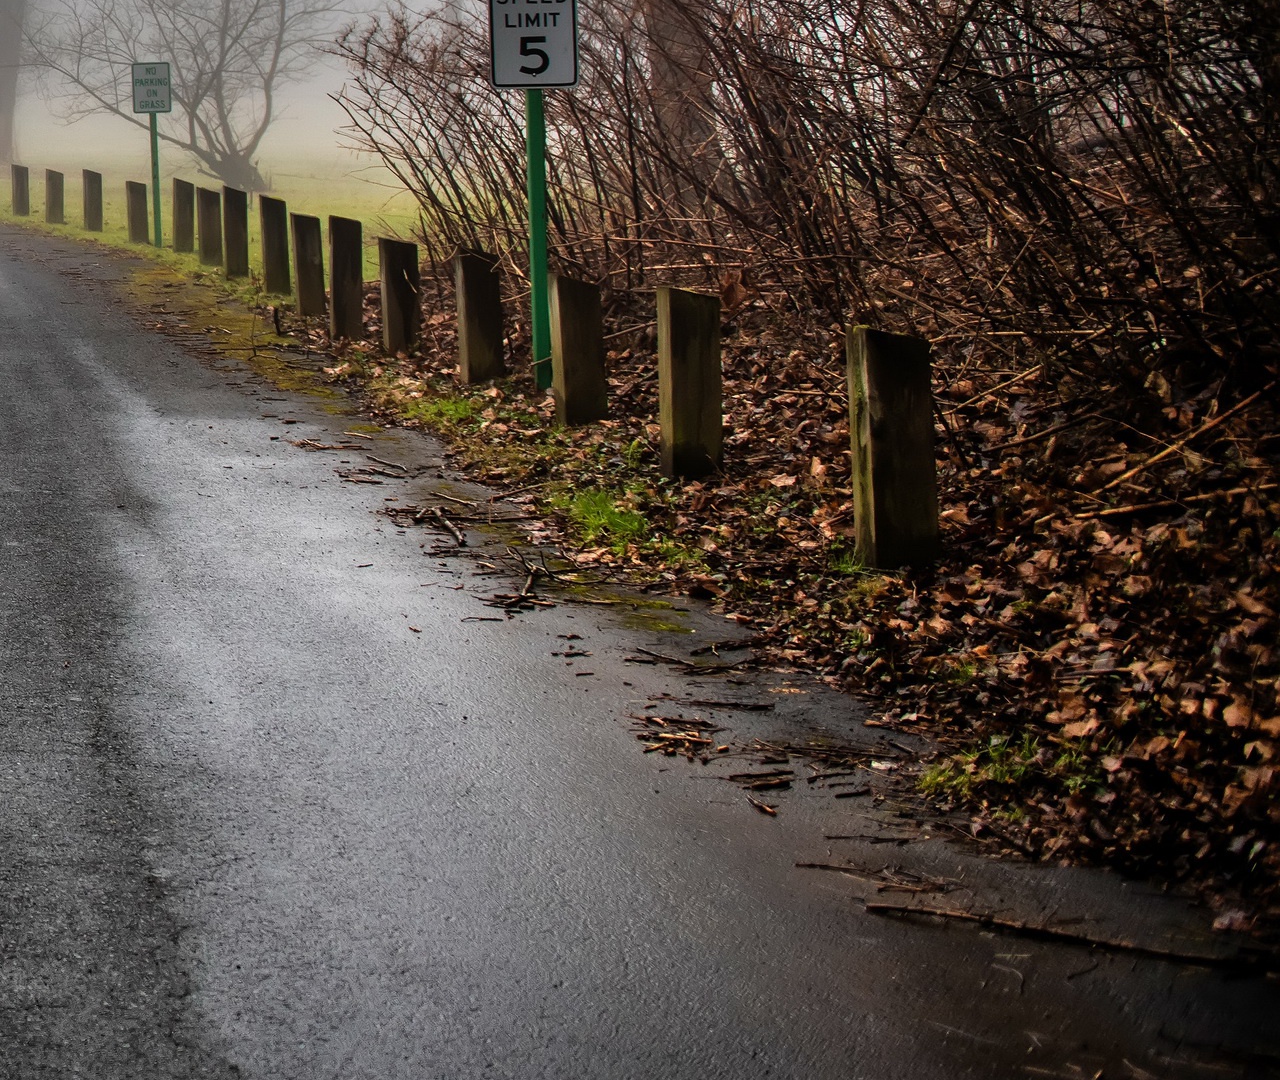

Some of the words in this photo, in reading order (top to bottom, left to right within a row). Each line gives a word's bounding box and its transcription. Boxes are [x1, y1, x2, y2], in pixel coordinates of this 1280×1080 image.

[505, 13, 560, 28] LIMIT
[520, 36, 550, 75] 5
[146, 67, 156, 75] NO
[135, 78, 168, 86] PARKING
[147, 89, 157, 97] ON
[140, 100, 165, 109] GRASS
